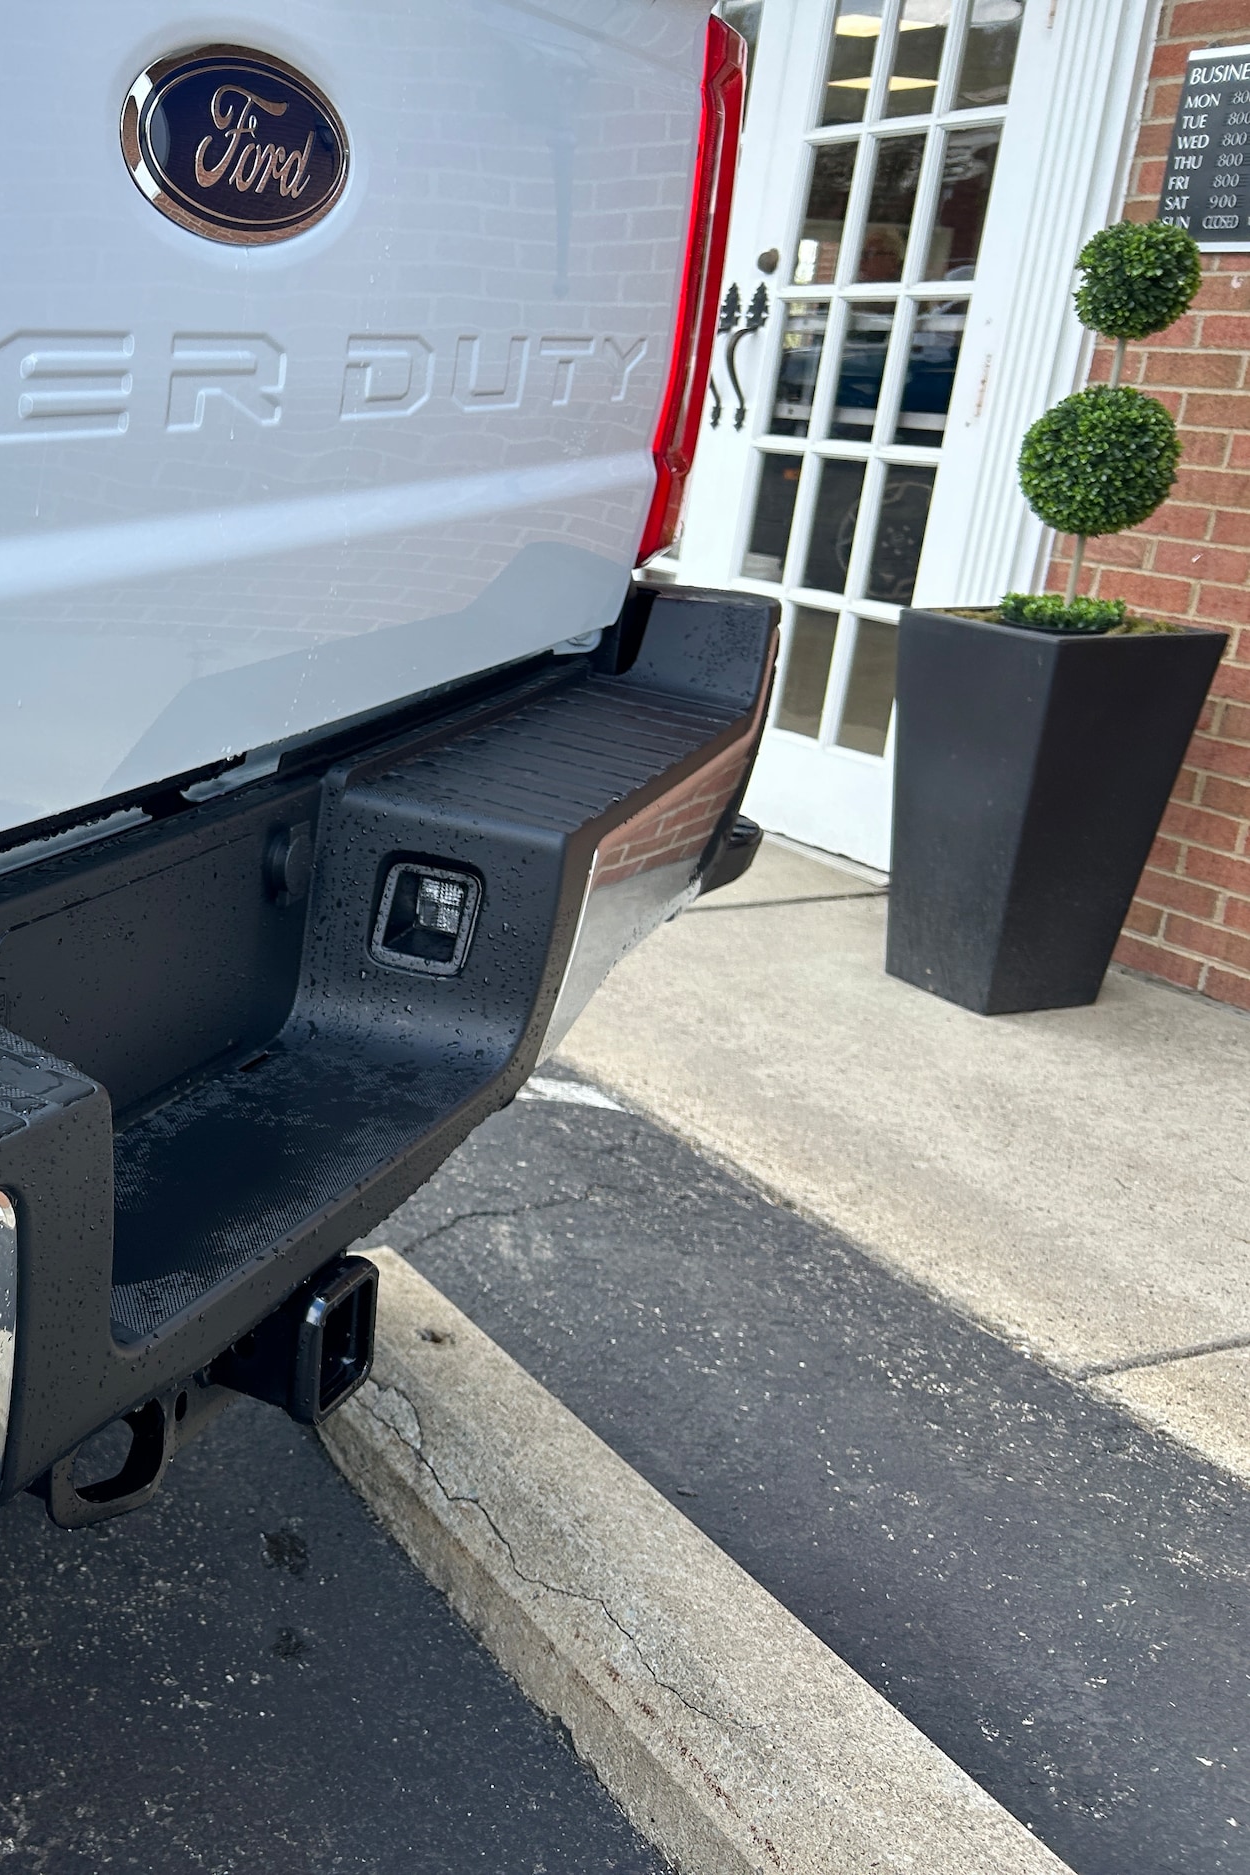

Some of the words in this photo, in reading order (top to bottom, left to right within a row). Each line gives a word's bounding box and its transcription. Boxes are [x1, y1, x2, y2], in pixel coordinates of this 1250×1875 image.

[1184, 93, 1222, 109] MON
[1232, 90, 1250, 105] 80
[1182, 114, 1209, 130] TUE
[195, 84, 316, 199] Ford
[1178, 134, 1210, 150] WED
[1222, 132, 1248, 147] 800
[1174, 155, 1204, 170] THU
[1217, 153, 1244, 168] 800
[1168, 175, 1190, 191] FRI
[1213, 173, 1240, 188] 800
[1164, 195, 1190, 211] SAT
[1209, 194, 1238, 209] 900
[340, 333, 649, 421] DUTY
